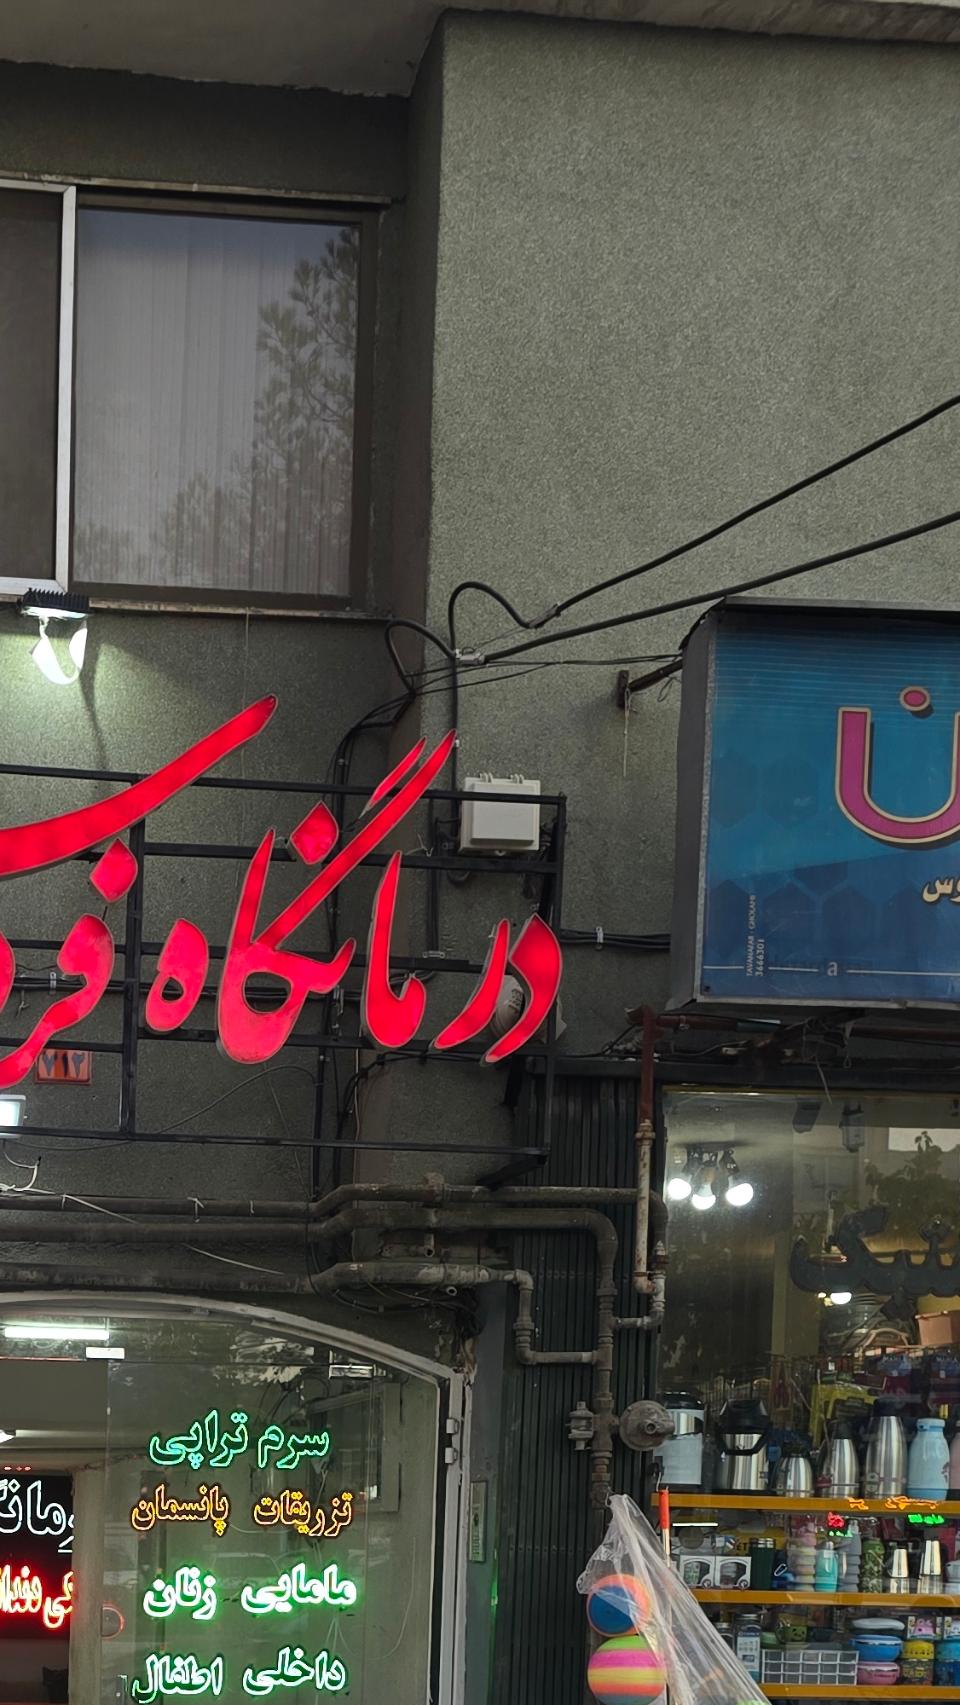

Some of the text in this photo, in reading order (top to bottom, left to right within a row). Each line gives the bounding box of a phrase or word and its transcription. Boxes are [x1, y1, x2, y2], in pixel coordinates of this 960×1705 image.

[143, 729, 564, 1065] درمانگاه
[148, 1409, 330, 1470] سرم تراپی
[131, 1483, 354, 1537] تزریقات پانسمان
[142, 1563, 358, 1620] مامایی زنان
[132, 1646, 347, 1704] داخلی اطفال
